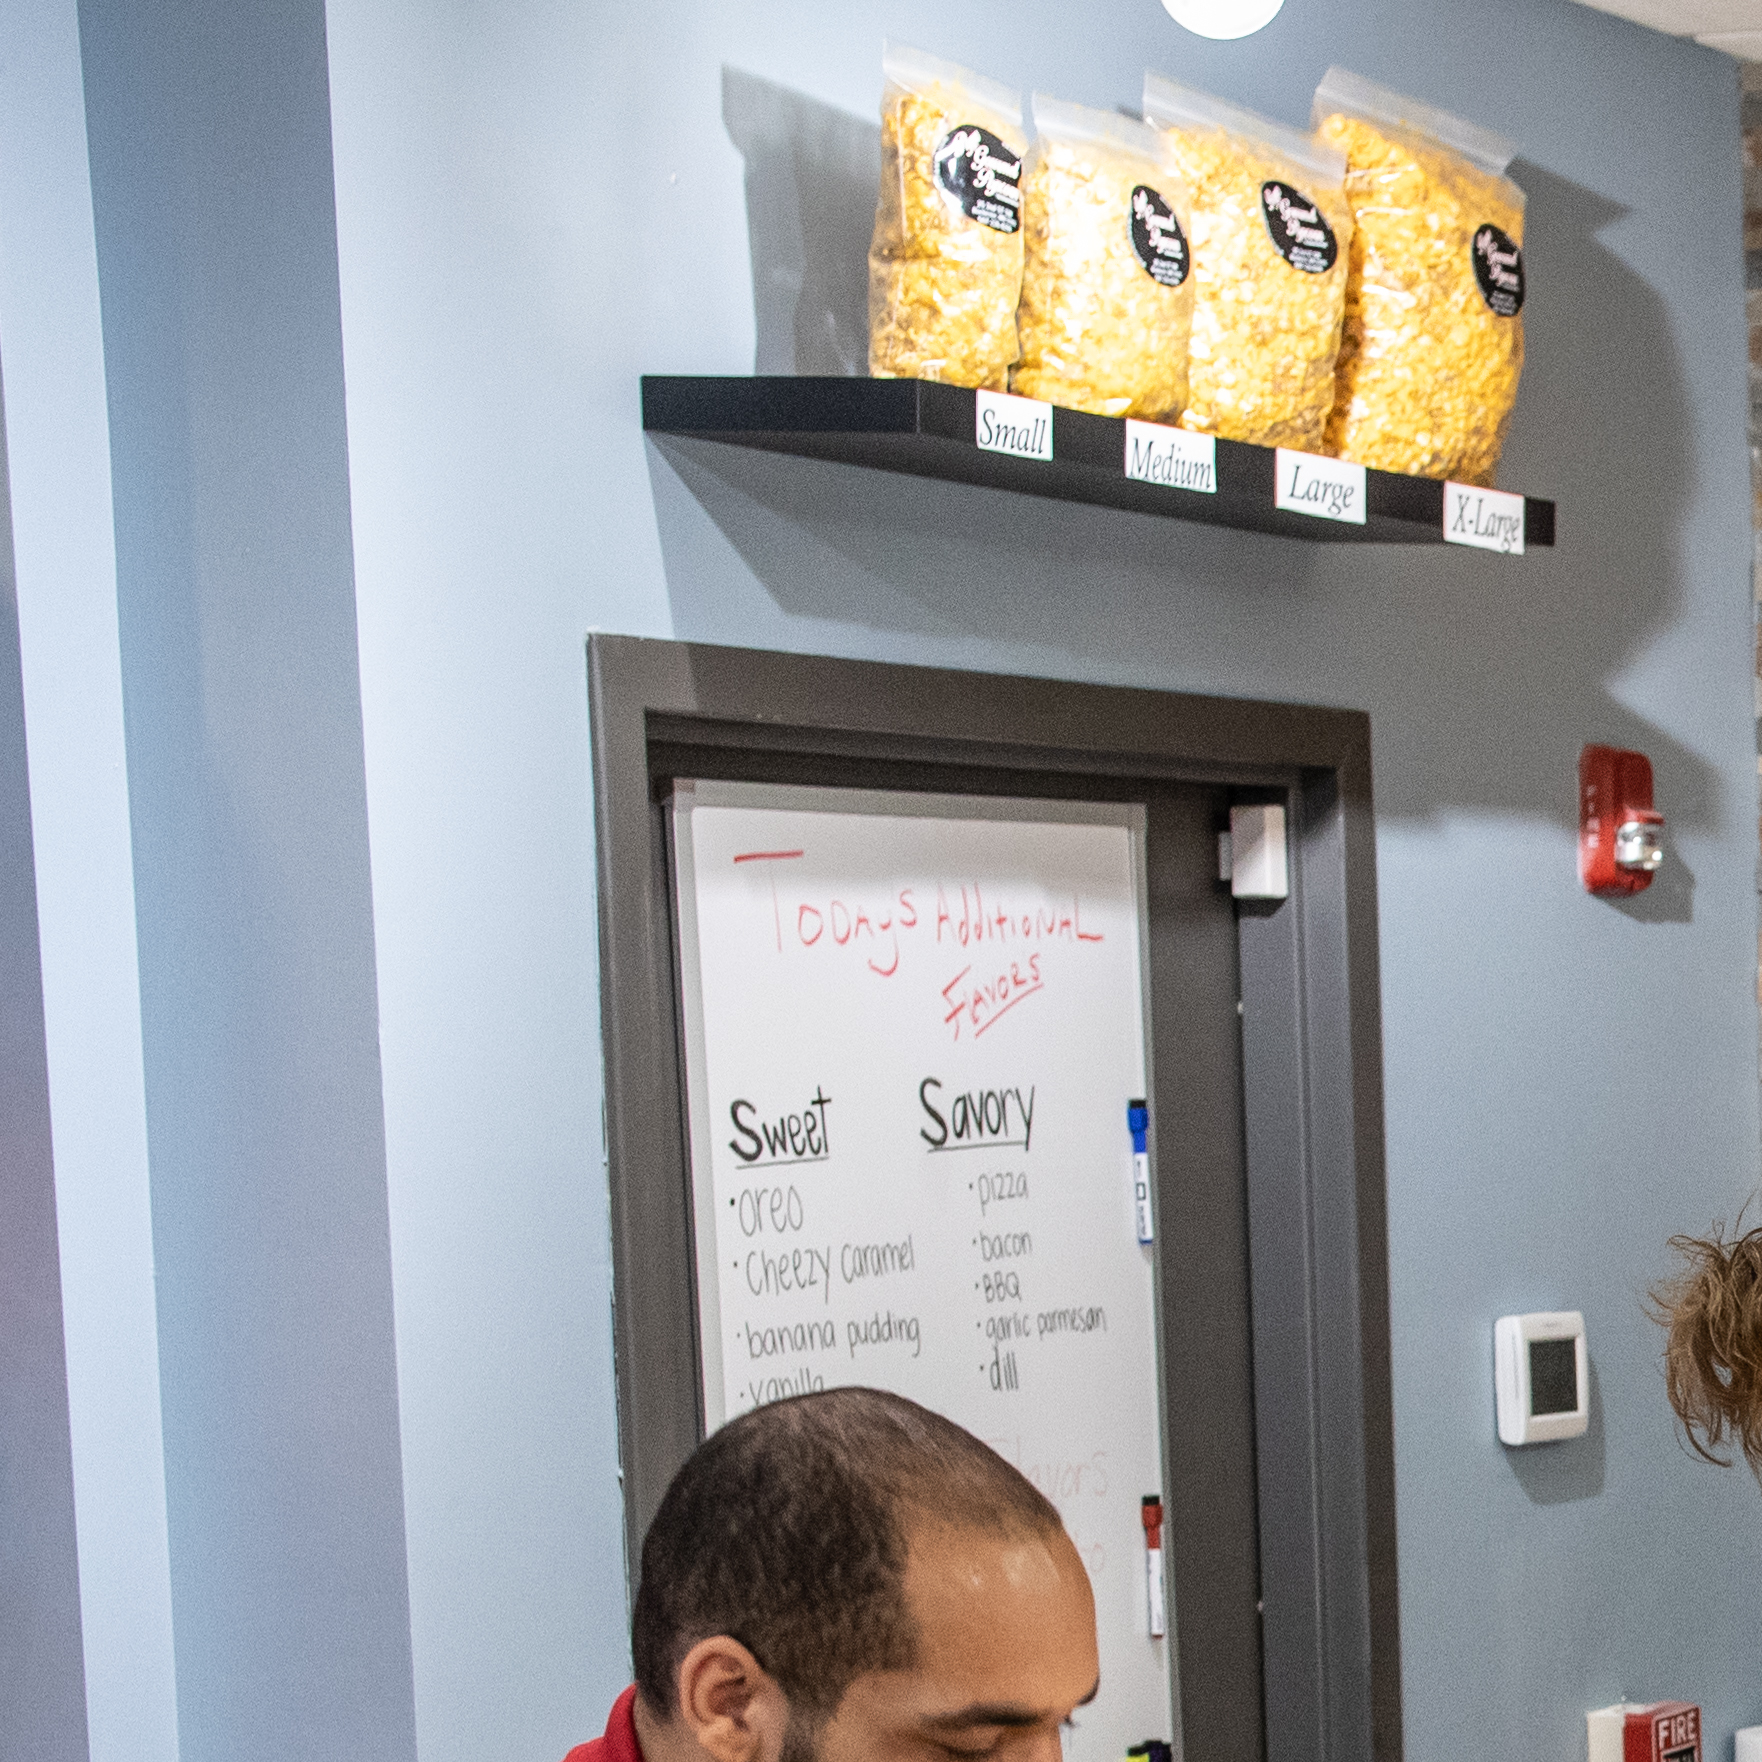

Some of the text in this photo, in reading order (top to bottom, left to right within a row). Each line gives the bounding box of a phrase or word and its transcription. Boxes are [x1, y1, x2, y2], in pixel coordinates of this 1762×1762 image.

[979, 408, 1046, 455] Small
[1131, 437, 1212, 488] Medium
[1289, 464, 1354, 512] Large
[1451, 494, 1522, 551] X-Large
[729, 1085, 832, 1162] Sweet
[919, 1076, 1035, 1152] Savory
[739, 1185, 803, 1237] oreo
[978, 1171, 1029, 1217] pizza
[980, 1230, 1032, 1262] bacon
[982, 1271, 1022, 1303] BBQ
[745, 1310, 920, 1358] banana pudding
[986, 1306, 1107, 1346] garlic parmesan
[990, 1346, 1019, 1392] dill
[1659, 1711, 1695, 1749] FIRE
